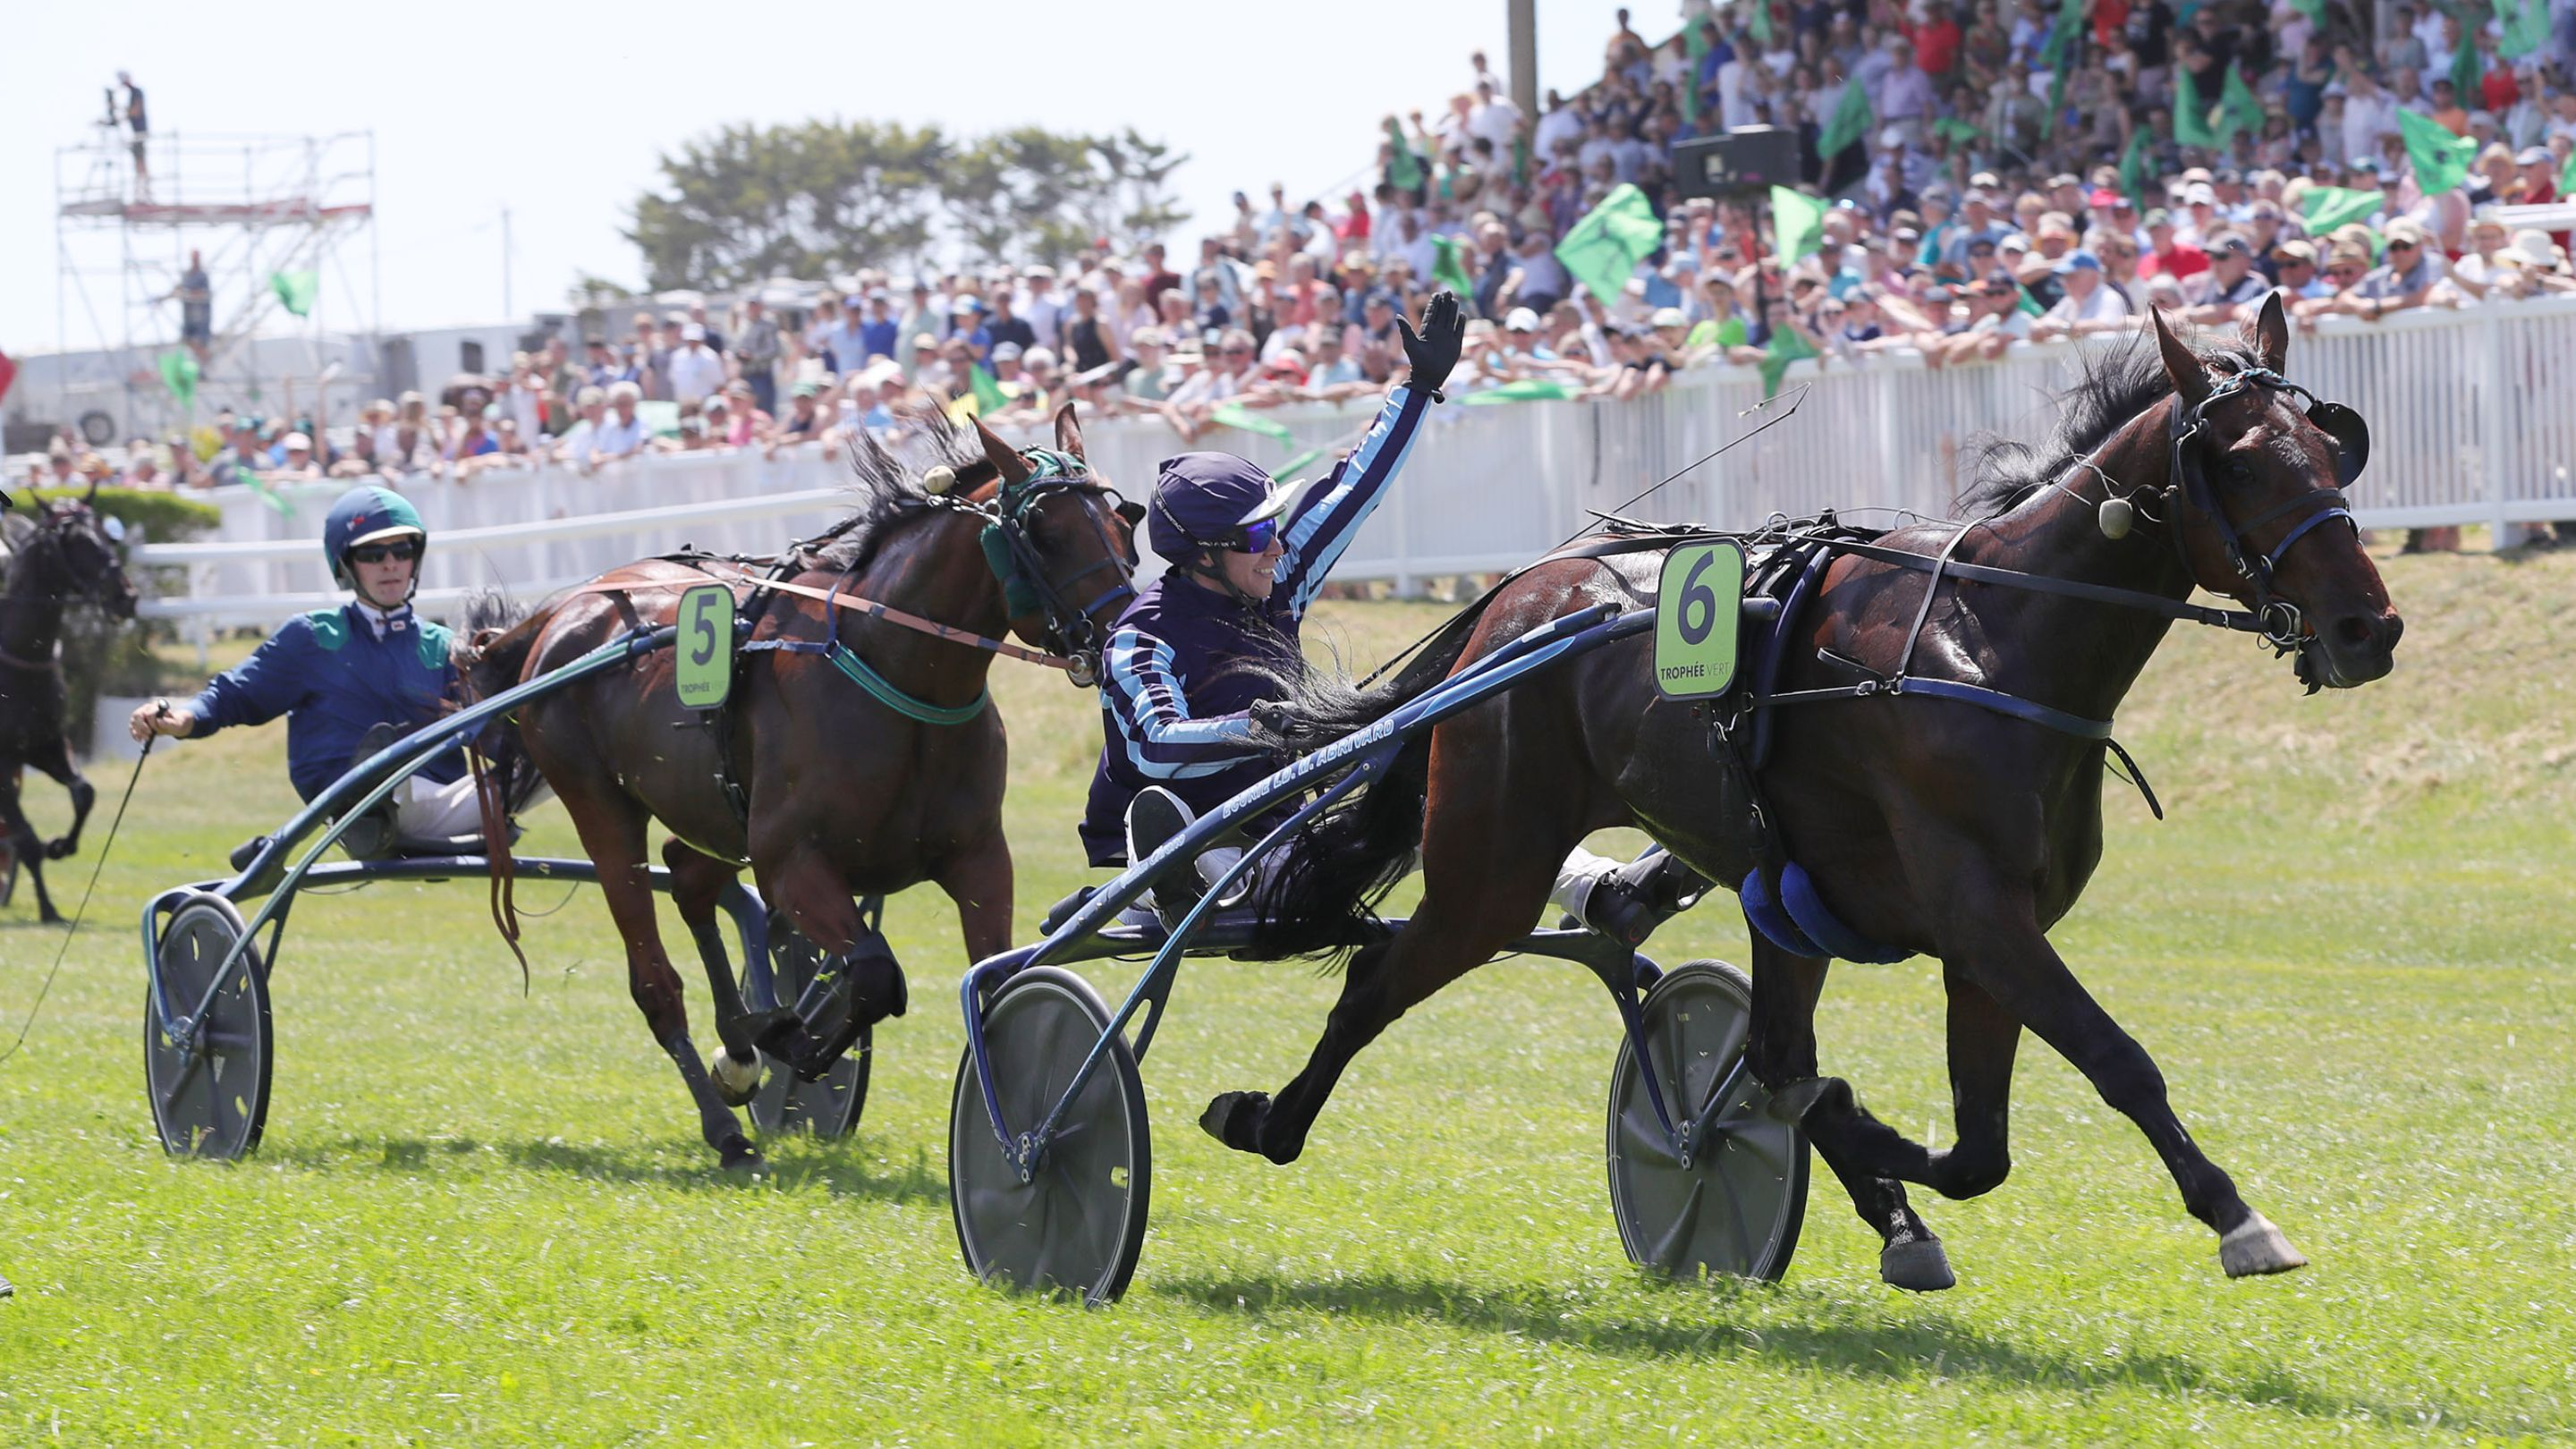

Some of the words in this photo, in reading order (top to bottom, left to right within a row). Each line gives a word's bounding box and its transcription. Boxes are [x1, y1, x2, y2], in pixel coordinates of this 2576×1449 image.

[1677, 549, 1716, 646] 6
[691, 593, 717, 666] 5
[1660, 661, 1705, 681] TROPHÉE
[1706, 662, 1729, 677] VERT
[1317, 718, 1395, 767] ABRIVARD
